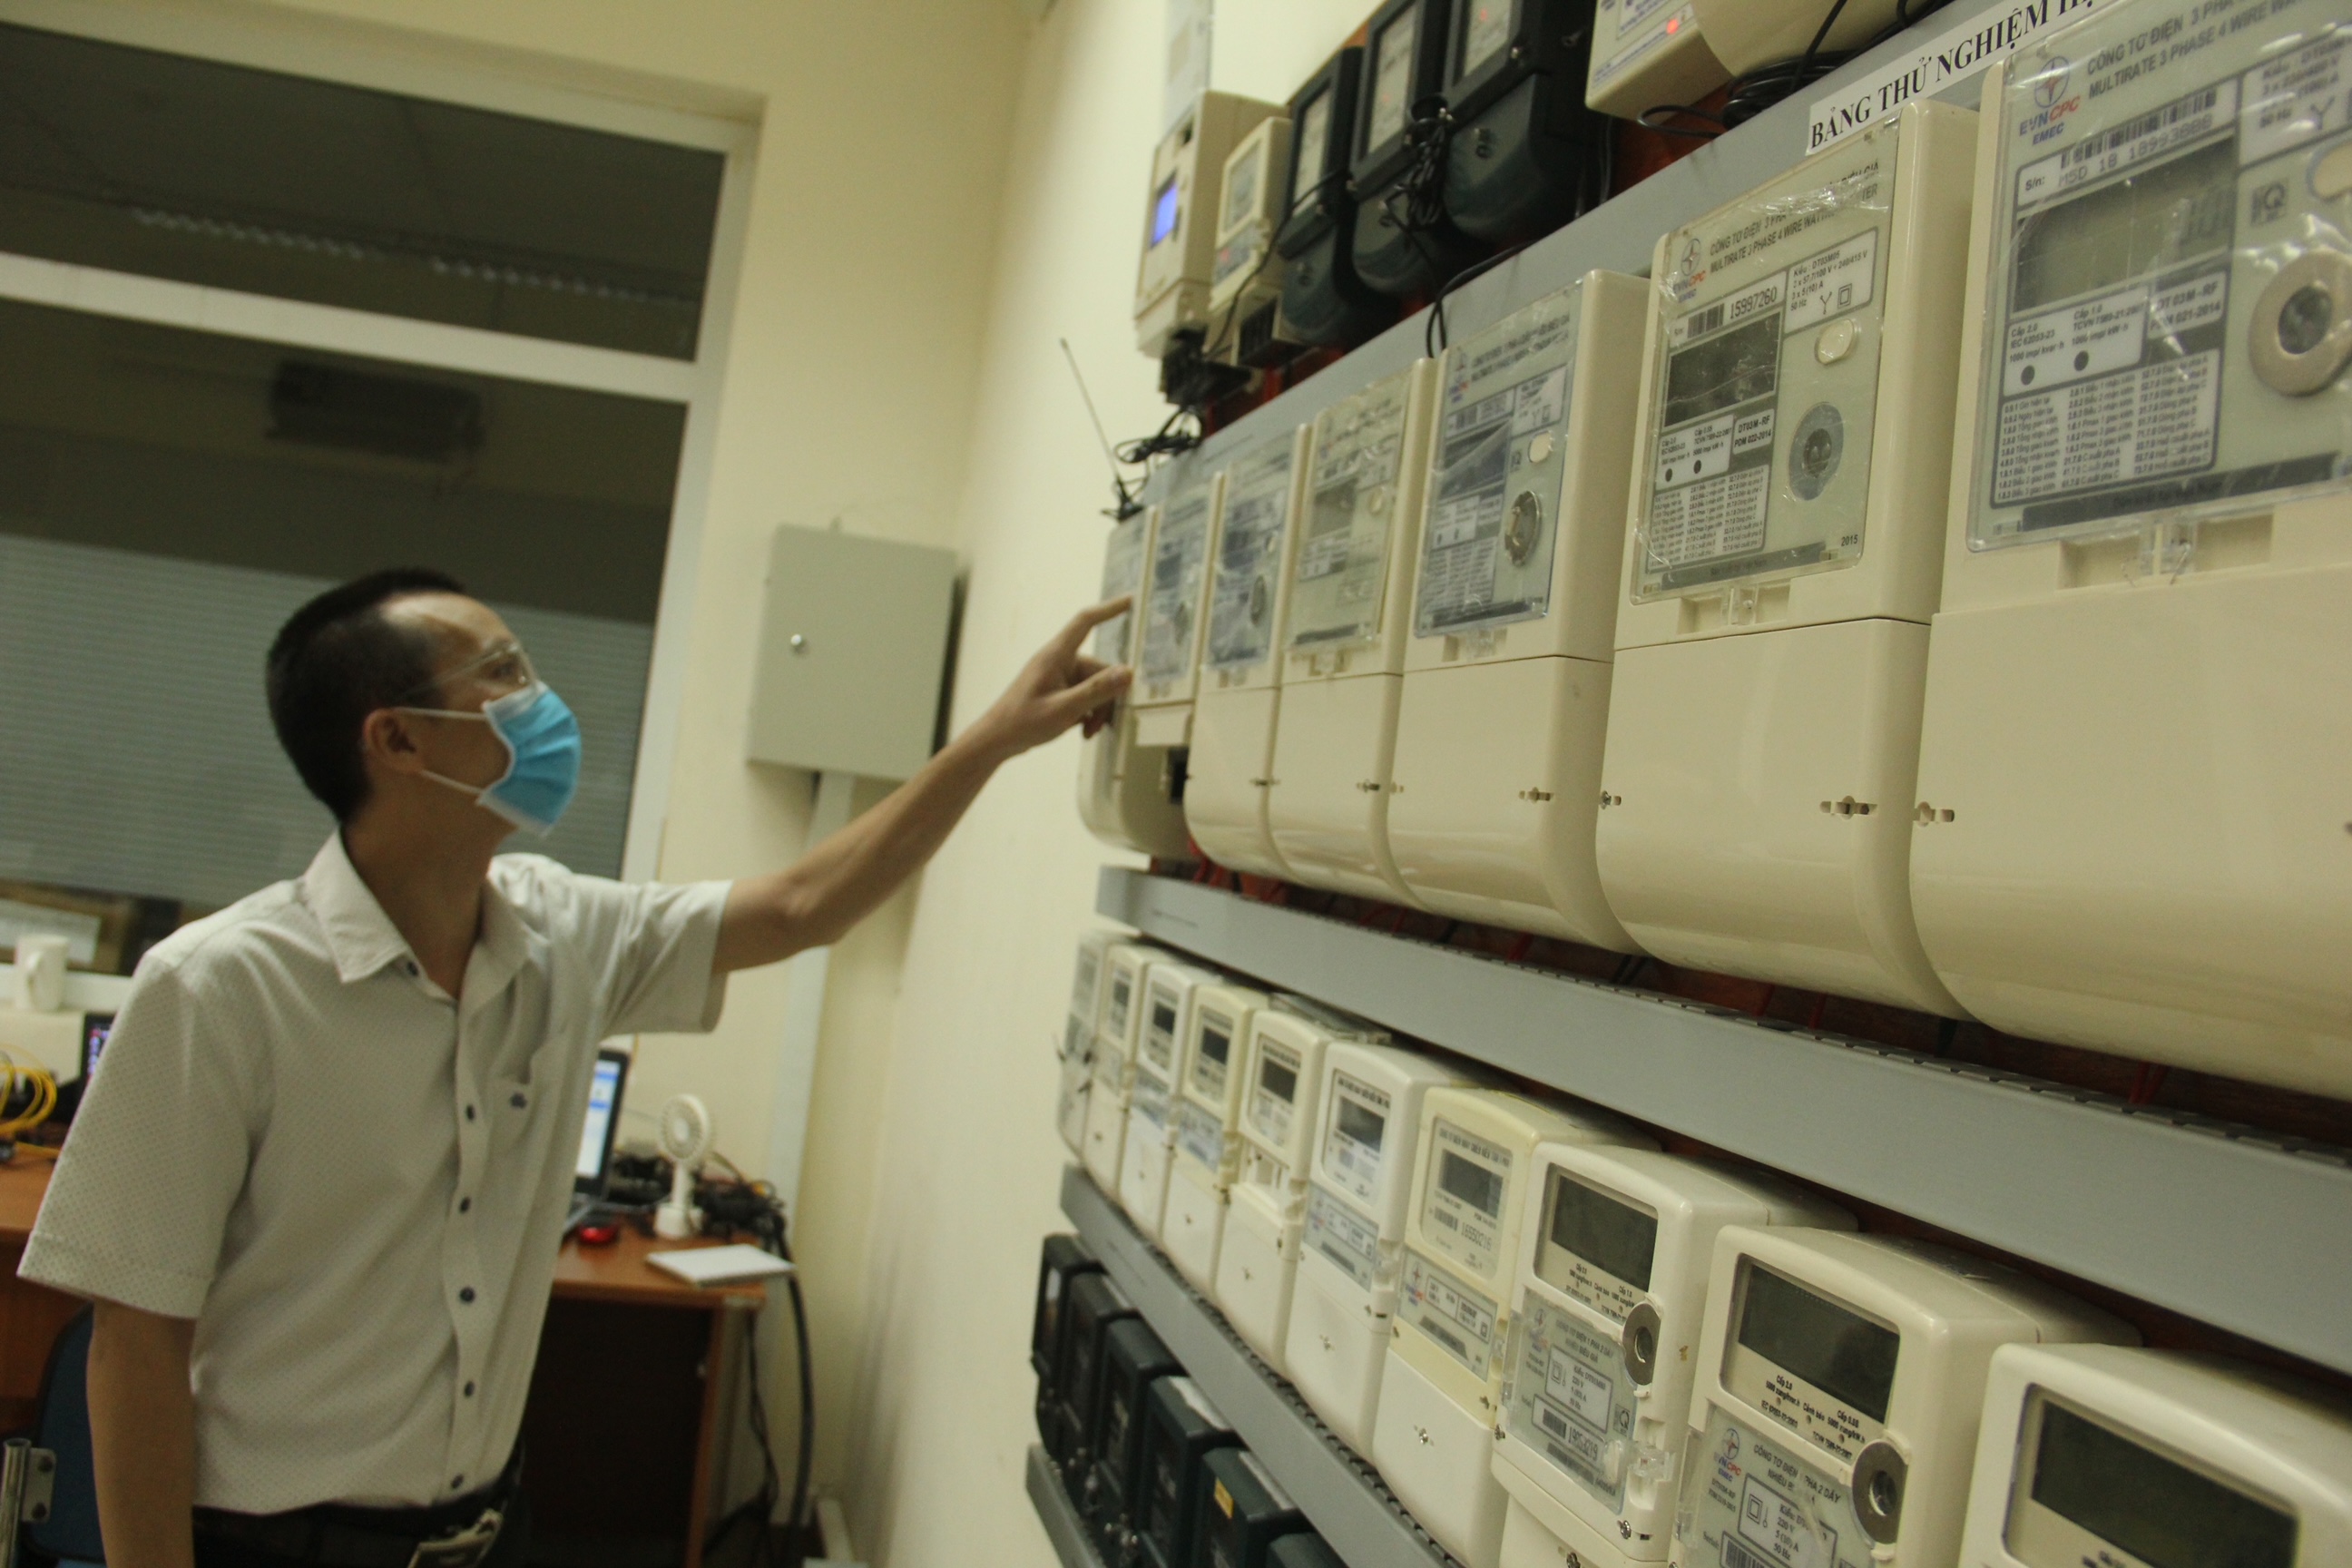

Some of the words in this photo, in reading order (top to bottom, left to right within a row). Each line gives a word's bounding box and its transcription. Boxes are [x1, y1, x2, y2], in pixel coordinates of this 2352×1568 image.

[1811, 94, 1871, 149] BẢNG
[1877, 56, 1932, 112] THỬ
[1935, 0, 2049, 83] NGHIỆM
[2089, 54, 2156, 99] MULTIRATE
[2160, 48, 2168, 67] 3
[2171, 25, 2215, 61] PHASE
[2033, 122, 2064, 145] EMEC
[1710, 250, 1746, 273] MULTIRATE
[1730, 286, 1777, 319] 15997260
[1840, 534, 1858, 547] 2015
[1754, 1444, 1771, 1462] CÔNG
[1818, 1485, 1823, 1494] 2
[1793, 1543, 1799, 1553] A
